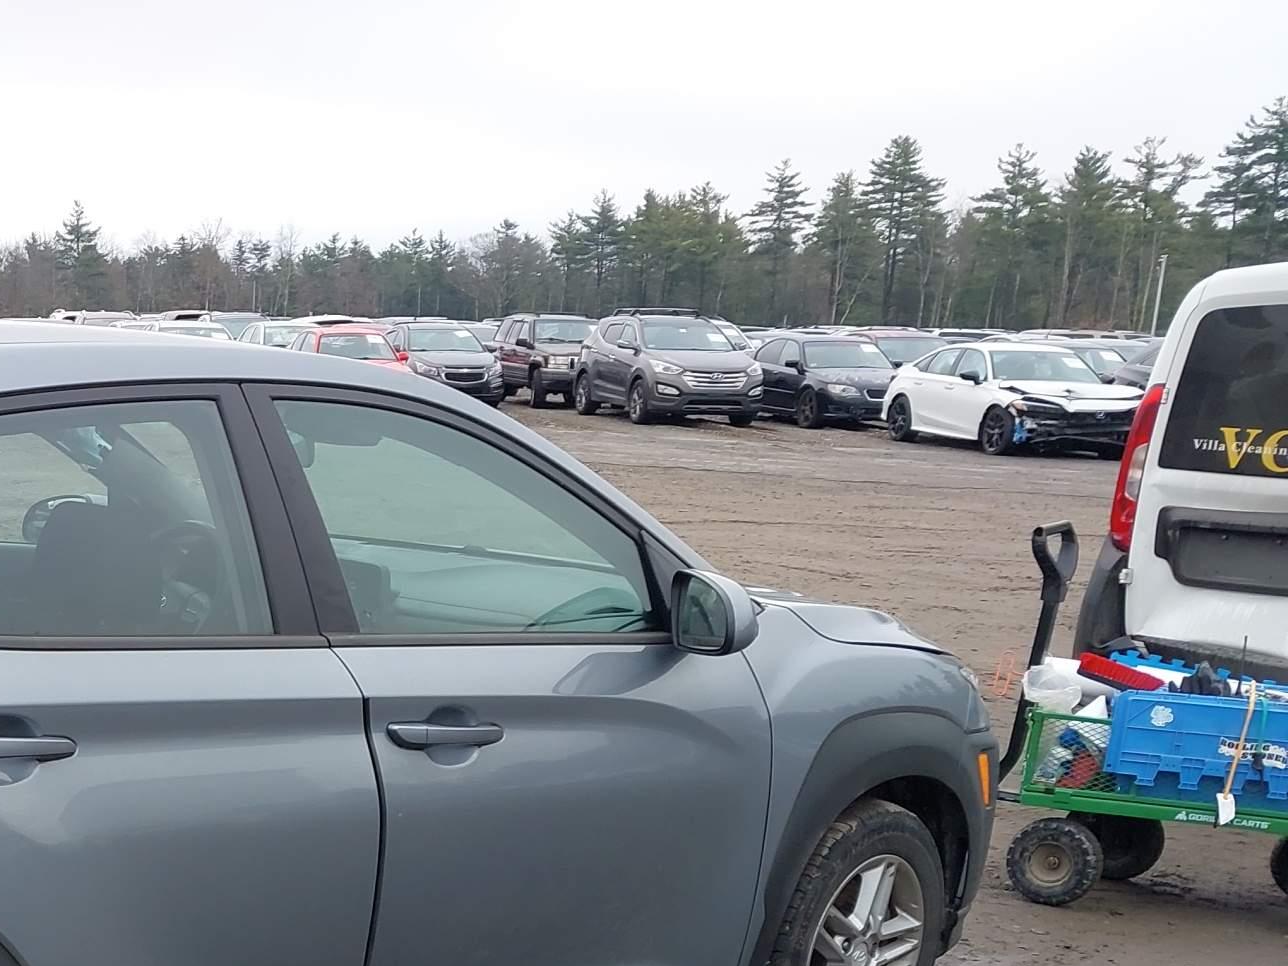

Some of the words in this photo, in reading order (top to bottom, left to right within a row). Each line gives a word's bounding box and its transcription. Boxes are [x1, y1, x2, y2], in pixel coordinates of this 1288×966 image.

[1193, 438, 1225, 452] Villa
[1232, 441, 1288, 457] Cleanin
[1233, 818, 1271, 829] CARTS
